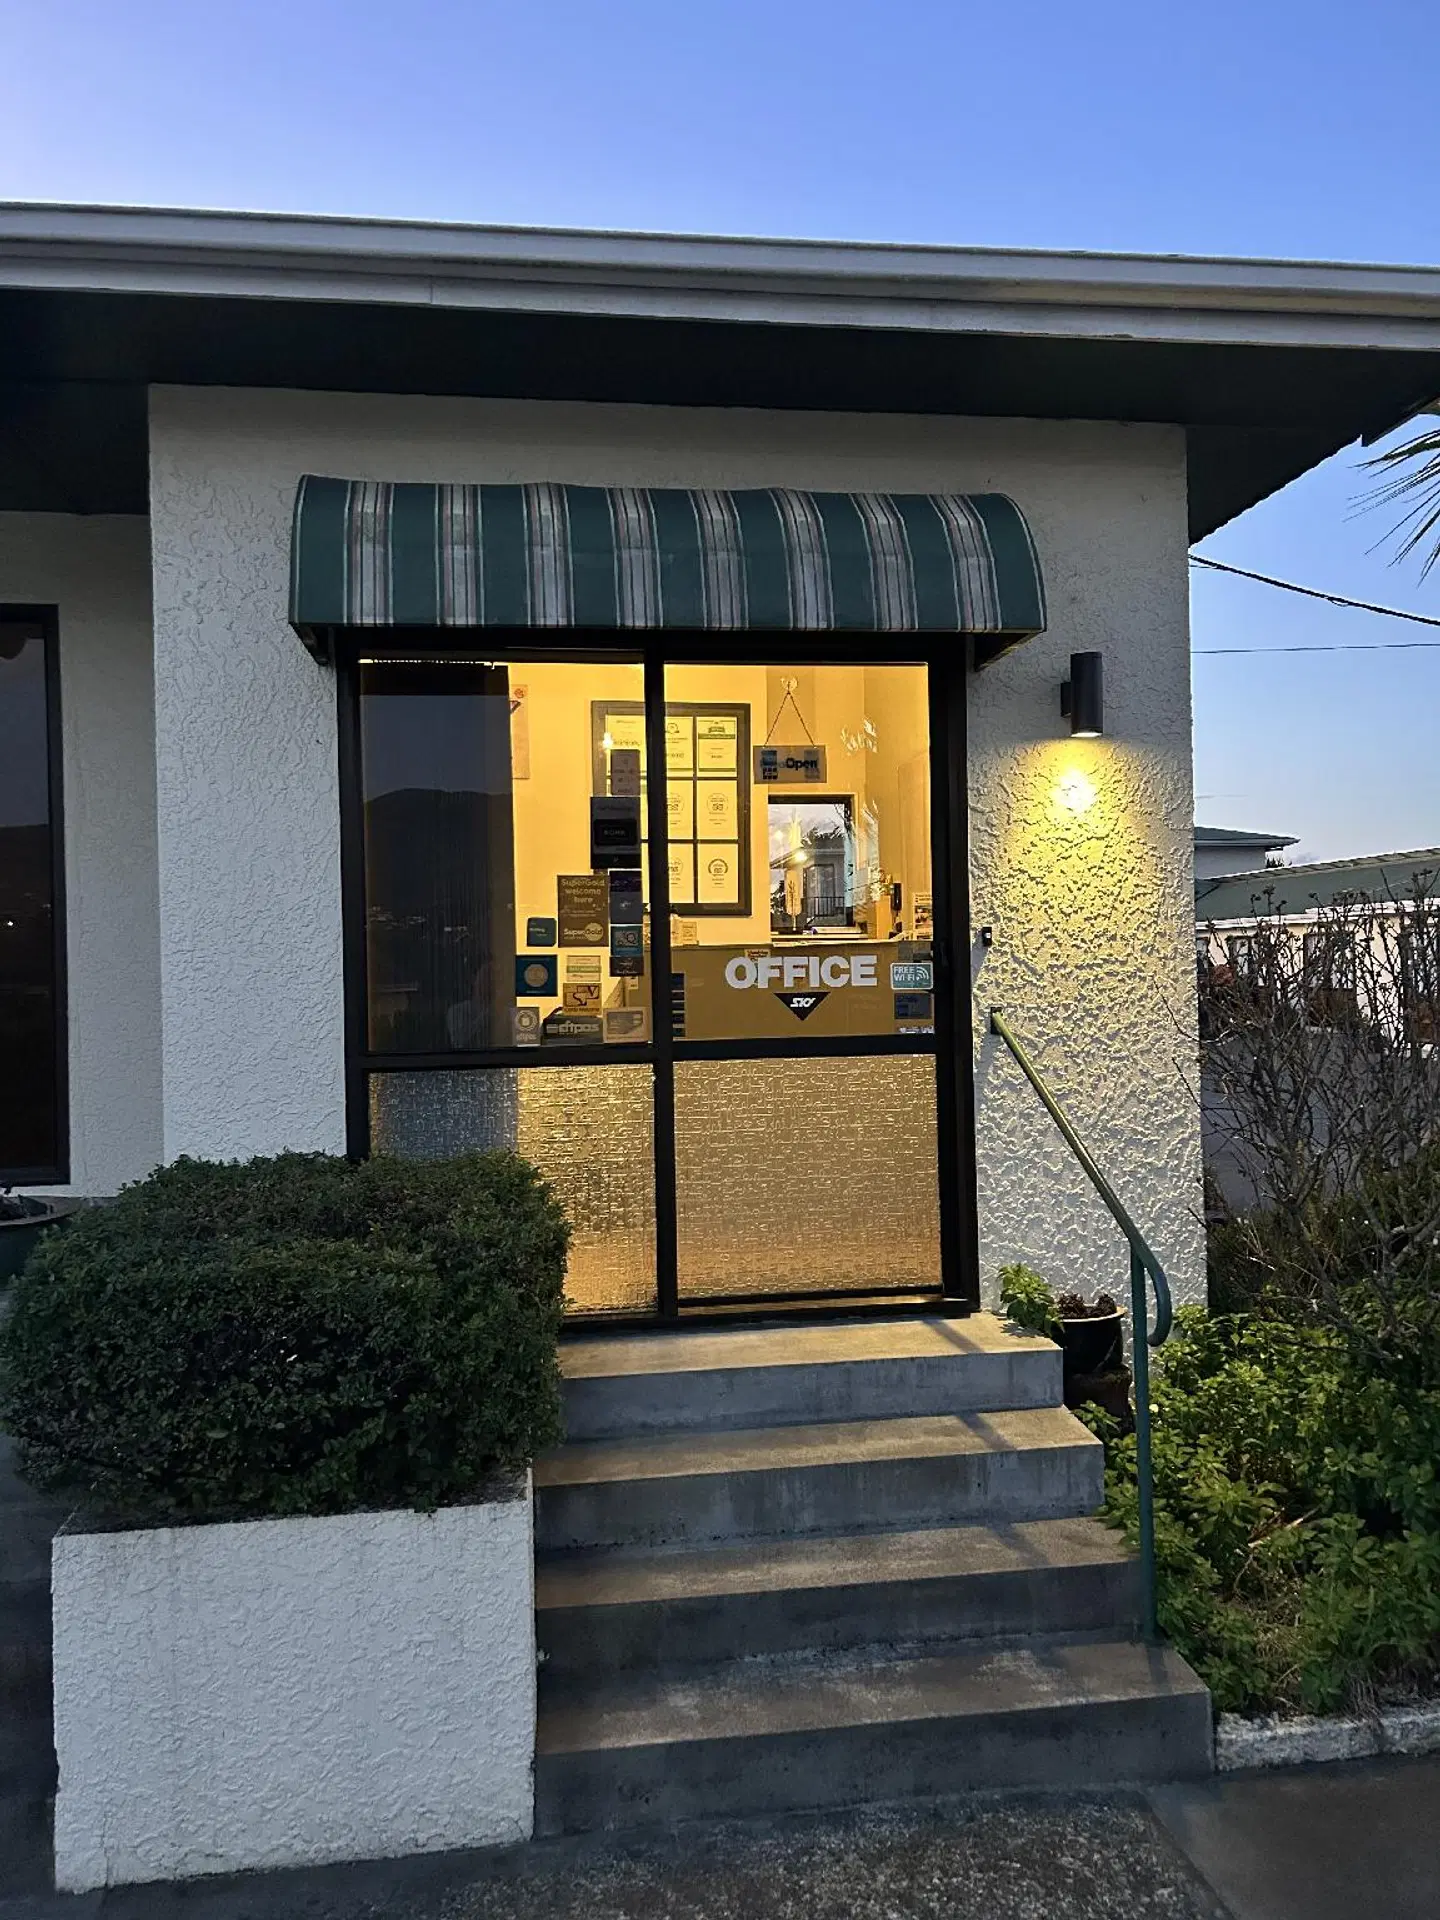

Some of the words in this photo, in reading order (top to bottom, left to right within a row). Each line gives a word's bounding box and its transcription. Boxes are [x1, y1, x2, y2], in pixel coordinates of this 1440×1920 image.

[786, 757, 818, 771] Open
[561, 877, 605, 887] SuperGold
[564, 887, 601, 895] welcome
[725, 955, 878, 989] OFFICE
[894, 966, 915, 974] FREE
[559, 1021, 599, 1034] eftpos
